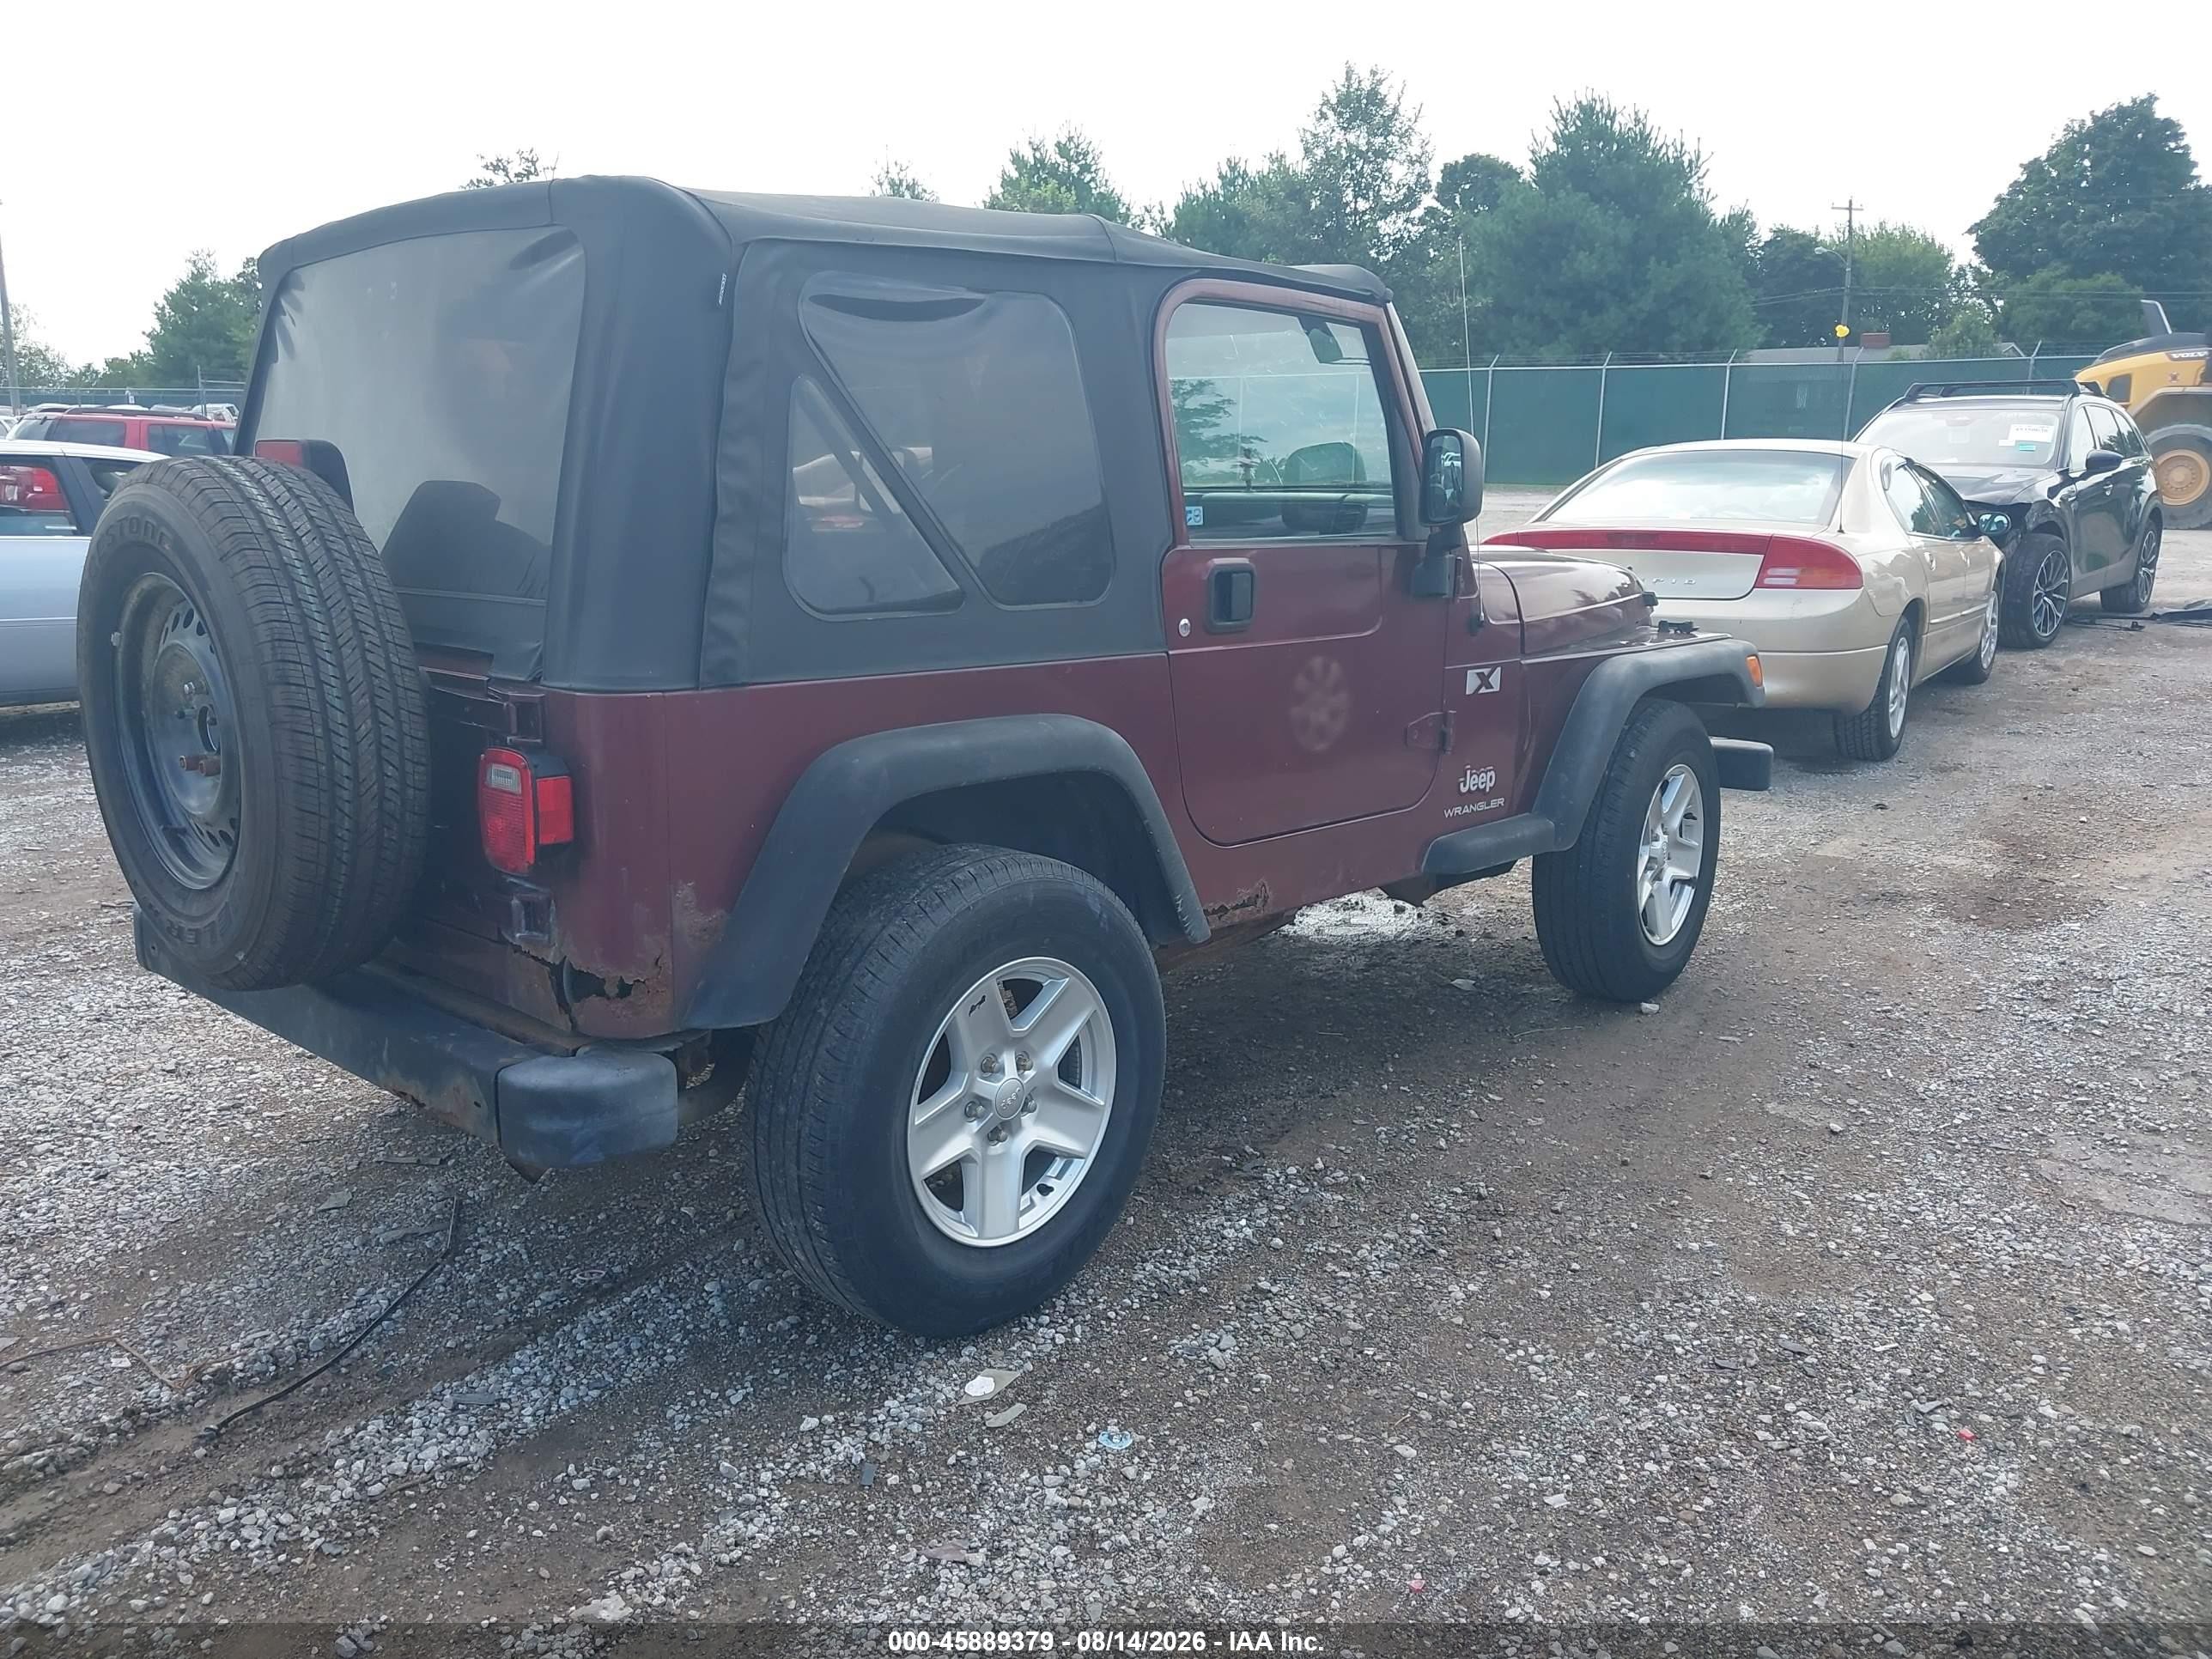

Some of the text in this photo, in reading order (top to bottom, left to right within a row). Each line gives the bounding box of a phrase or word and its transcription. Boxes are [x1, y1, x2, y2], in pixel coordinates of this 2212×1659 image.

[2172, 350, 2209, 359] VOLV
[1467, 666, 1501, 695] X
[1458, 765, 1496, 793] Jeep
[1443, 798, 1505, 818] WRANGLER
